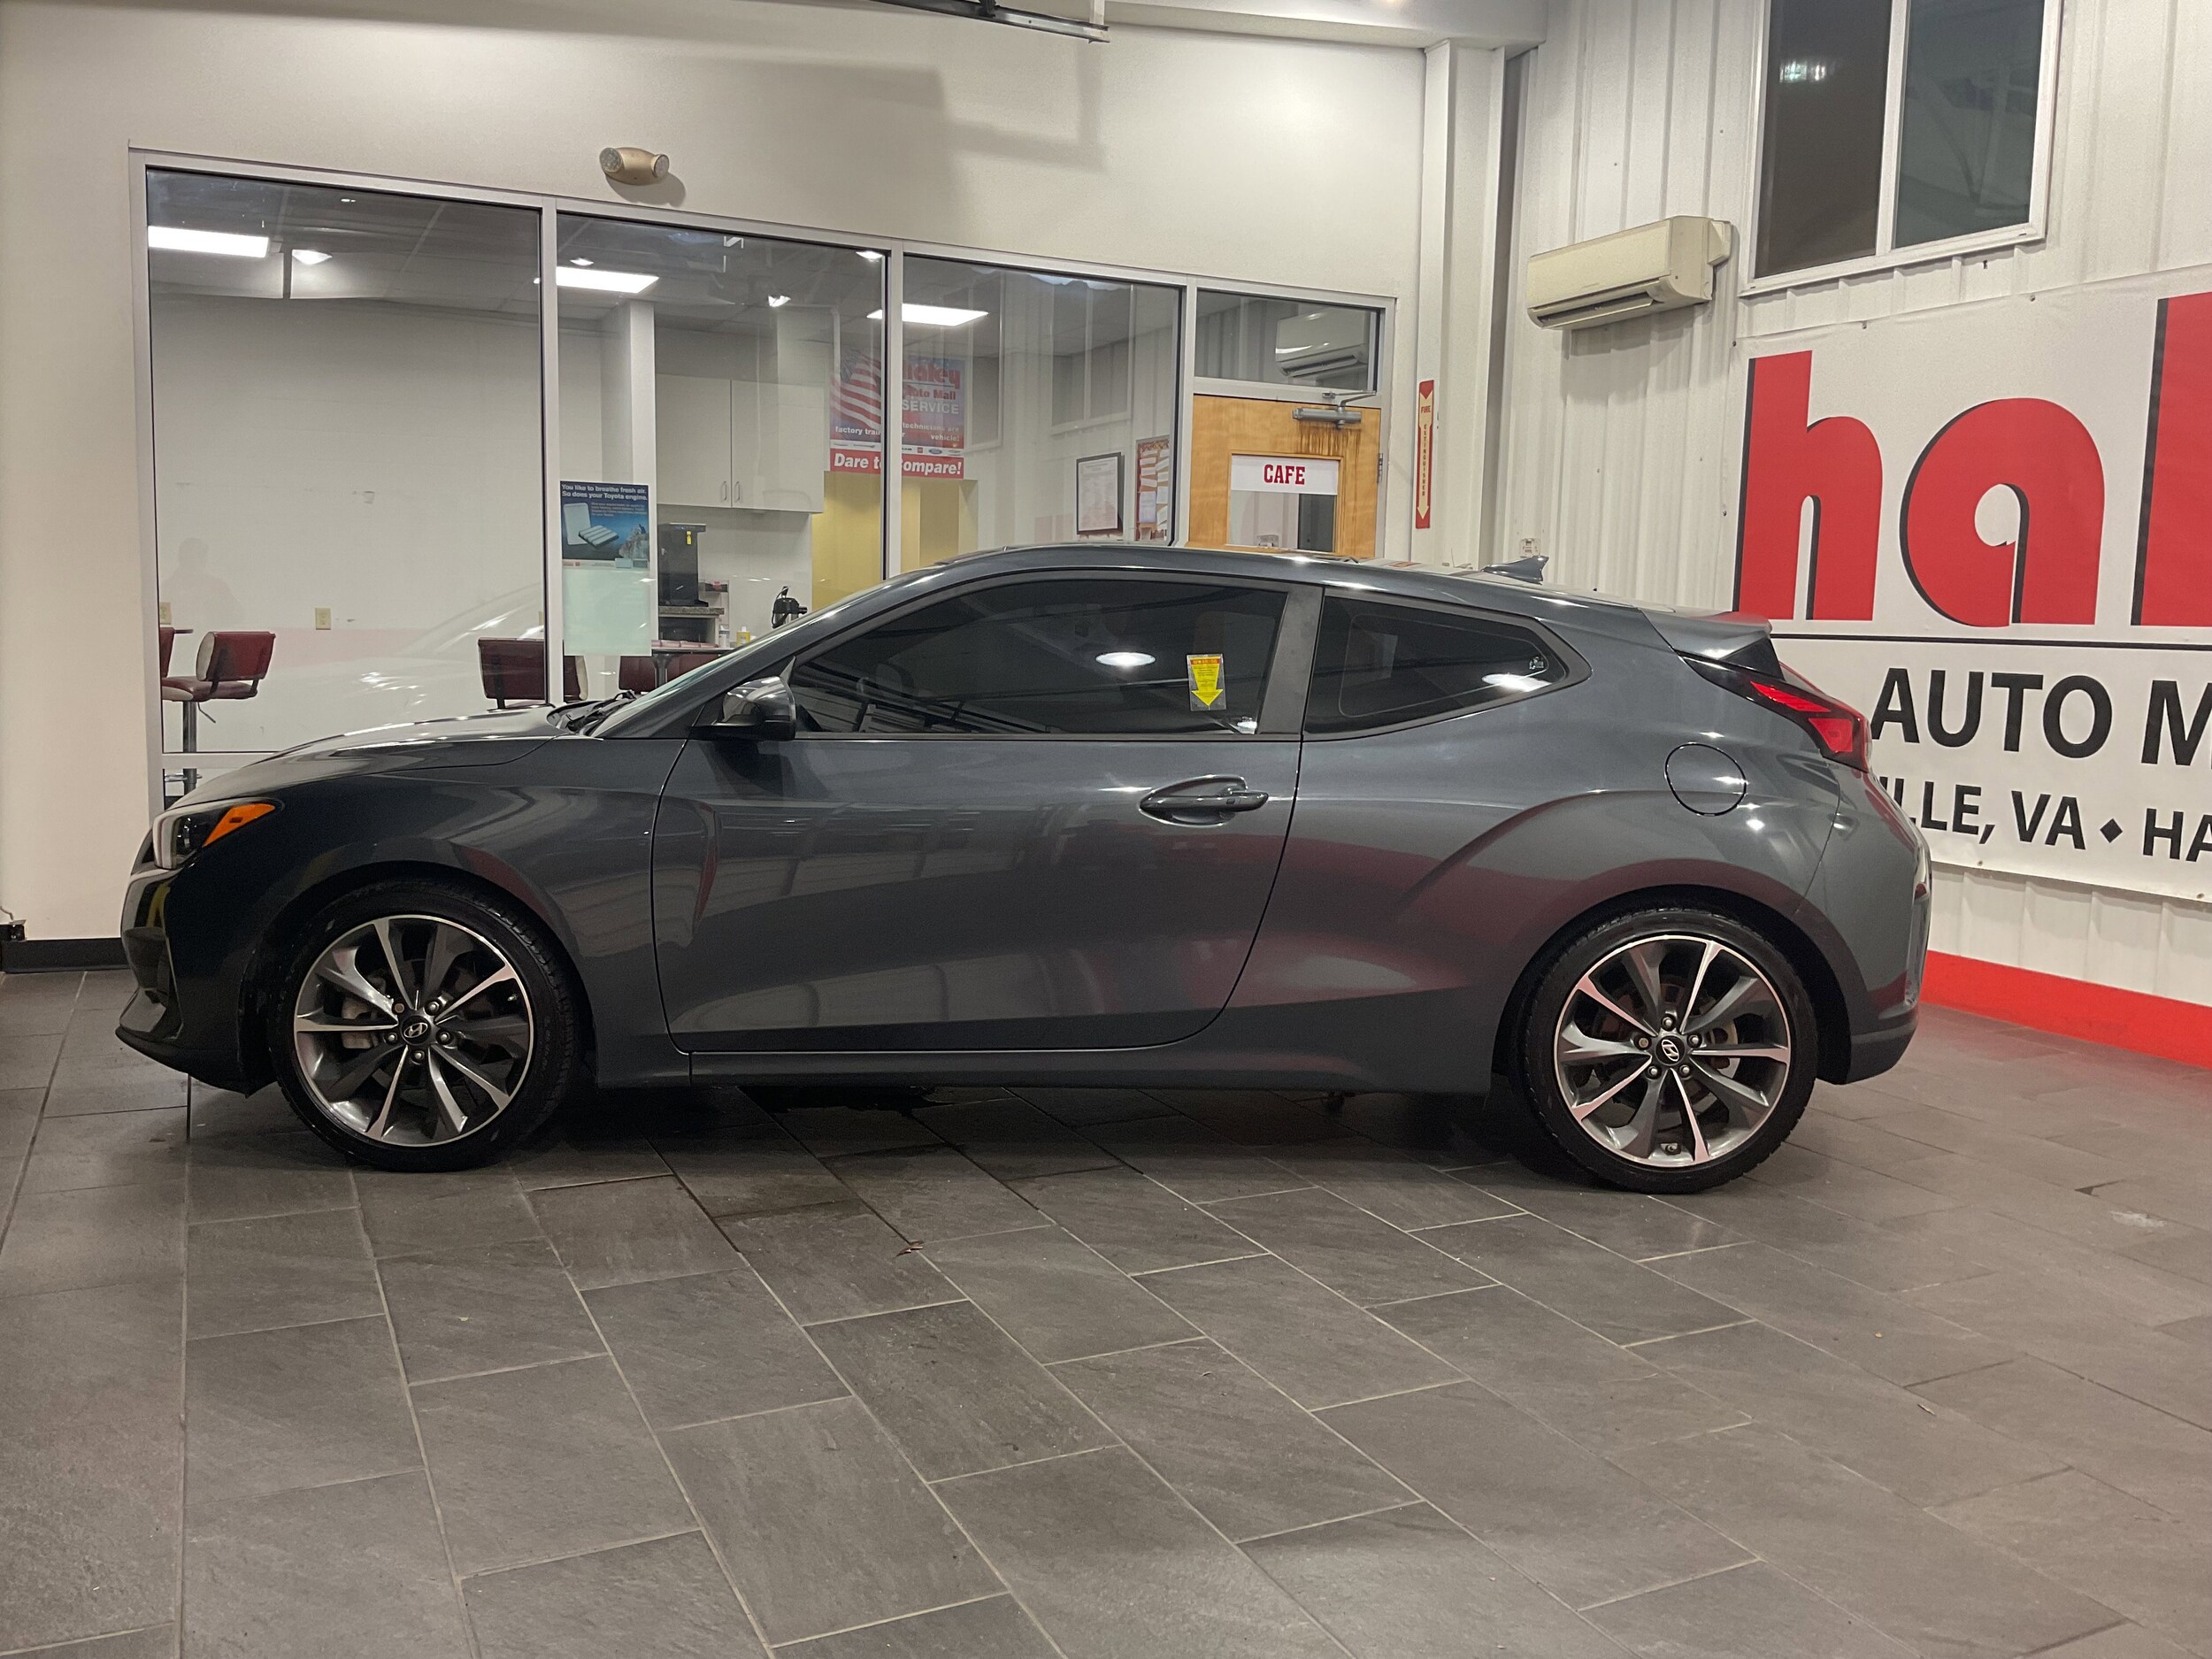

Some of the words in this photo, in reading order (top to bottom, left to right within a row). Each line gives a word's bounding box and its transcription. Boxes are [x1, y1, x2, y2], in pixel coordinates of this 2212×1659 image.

[933, 389, 956, 400] Mall
[902, 399, 959, 414] SERVICE
[835, 426, 863, 435] factory
[834, 453, 869, 469] Dare
[873, 456, 882, 470] t
[902, 460, 962, 475] ompare!
[1263, 464, 1305, 485] CAFE
[1870, 668, 2113, 758] AUTO
[2011, 790, 2085, 850] VA
